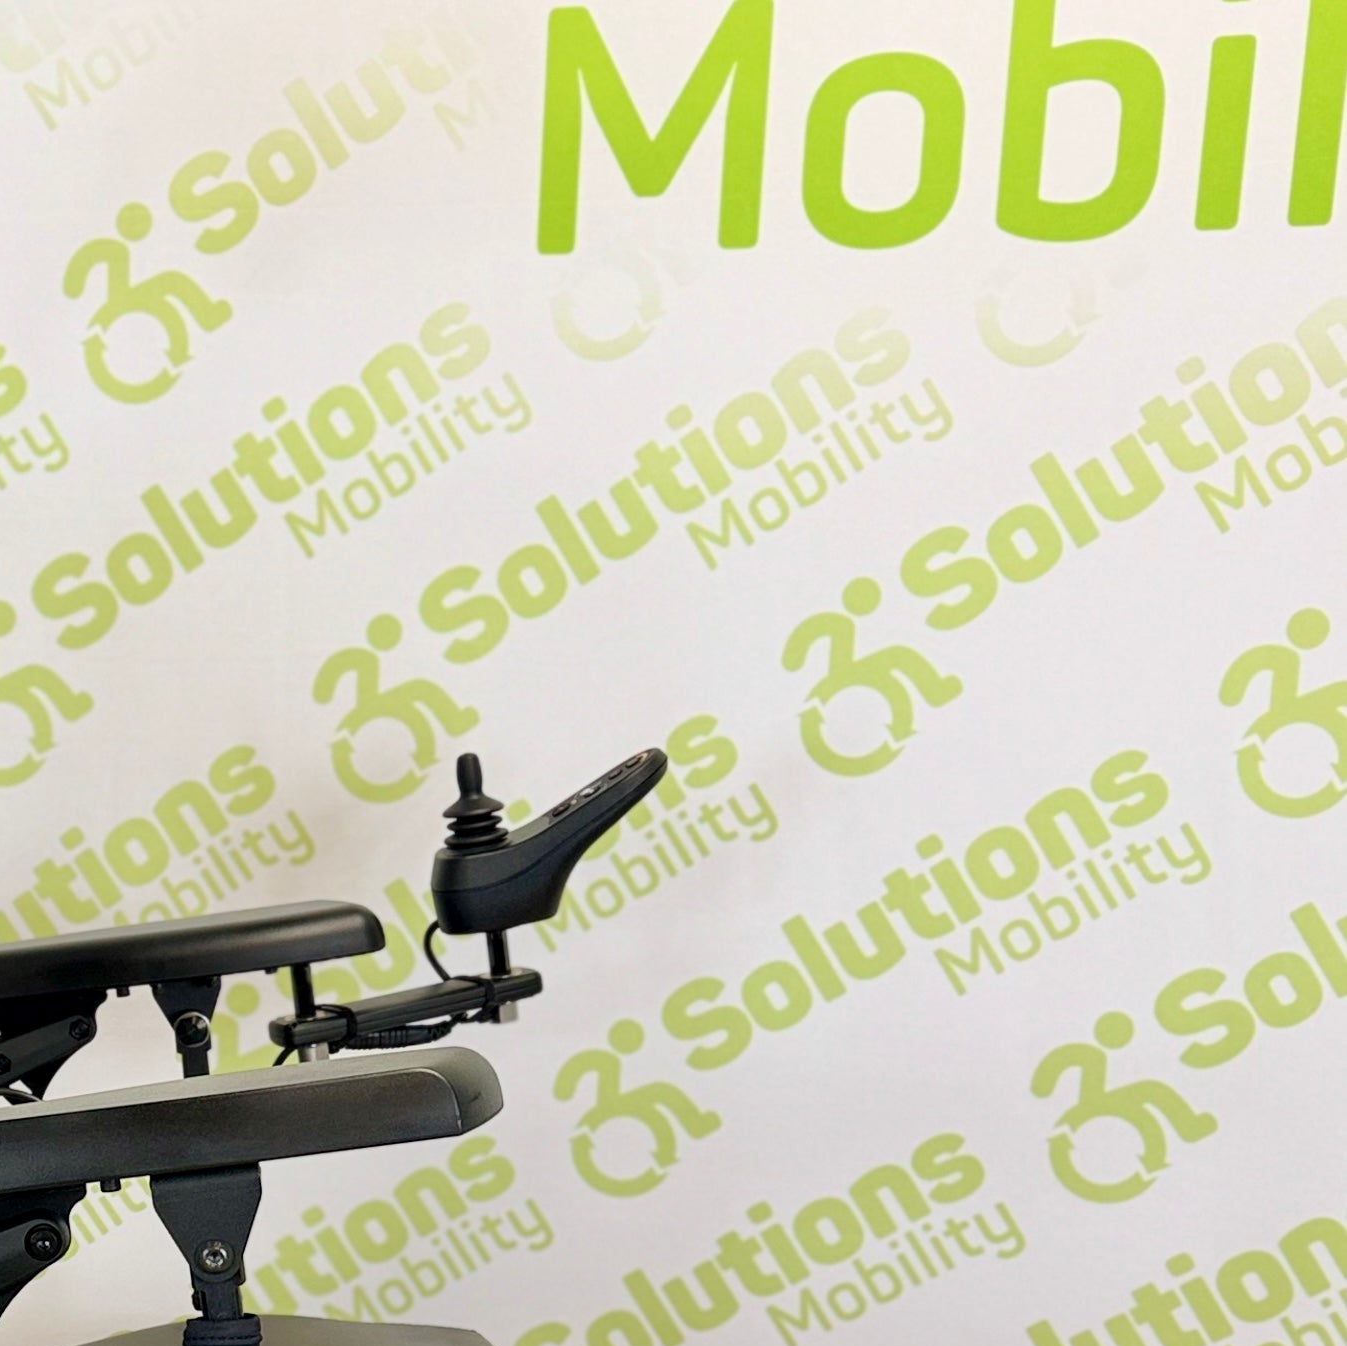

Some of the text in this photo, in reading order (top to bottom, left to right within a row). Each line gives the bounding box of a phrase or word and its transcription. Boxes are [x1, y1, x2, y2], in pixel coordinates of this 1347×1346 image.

[32, 300, 491, 649] Solutions
[284, 371, 534, 559] Mobility
[419, 305, 912, 664] Solutions
[685, 377, 954, 570] Mobility
[900, 295, 1347, 632] Solution
[533, 782, 778, 952] Mobility
[661, 749, 1169, 1071] Solutions
[934, 822, 1212, 995] Mobility
